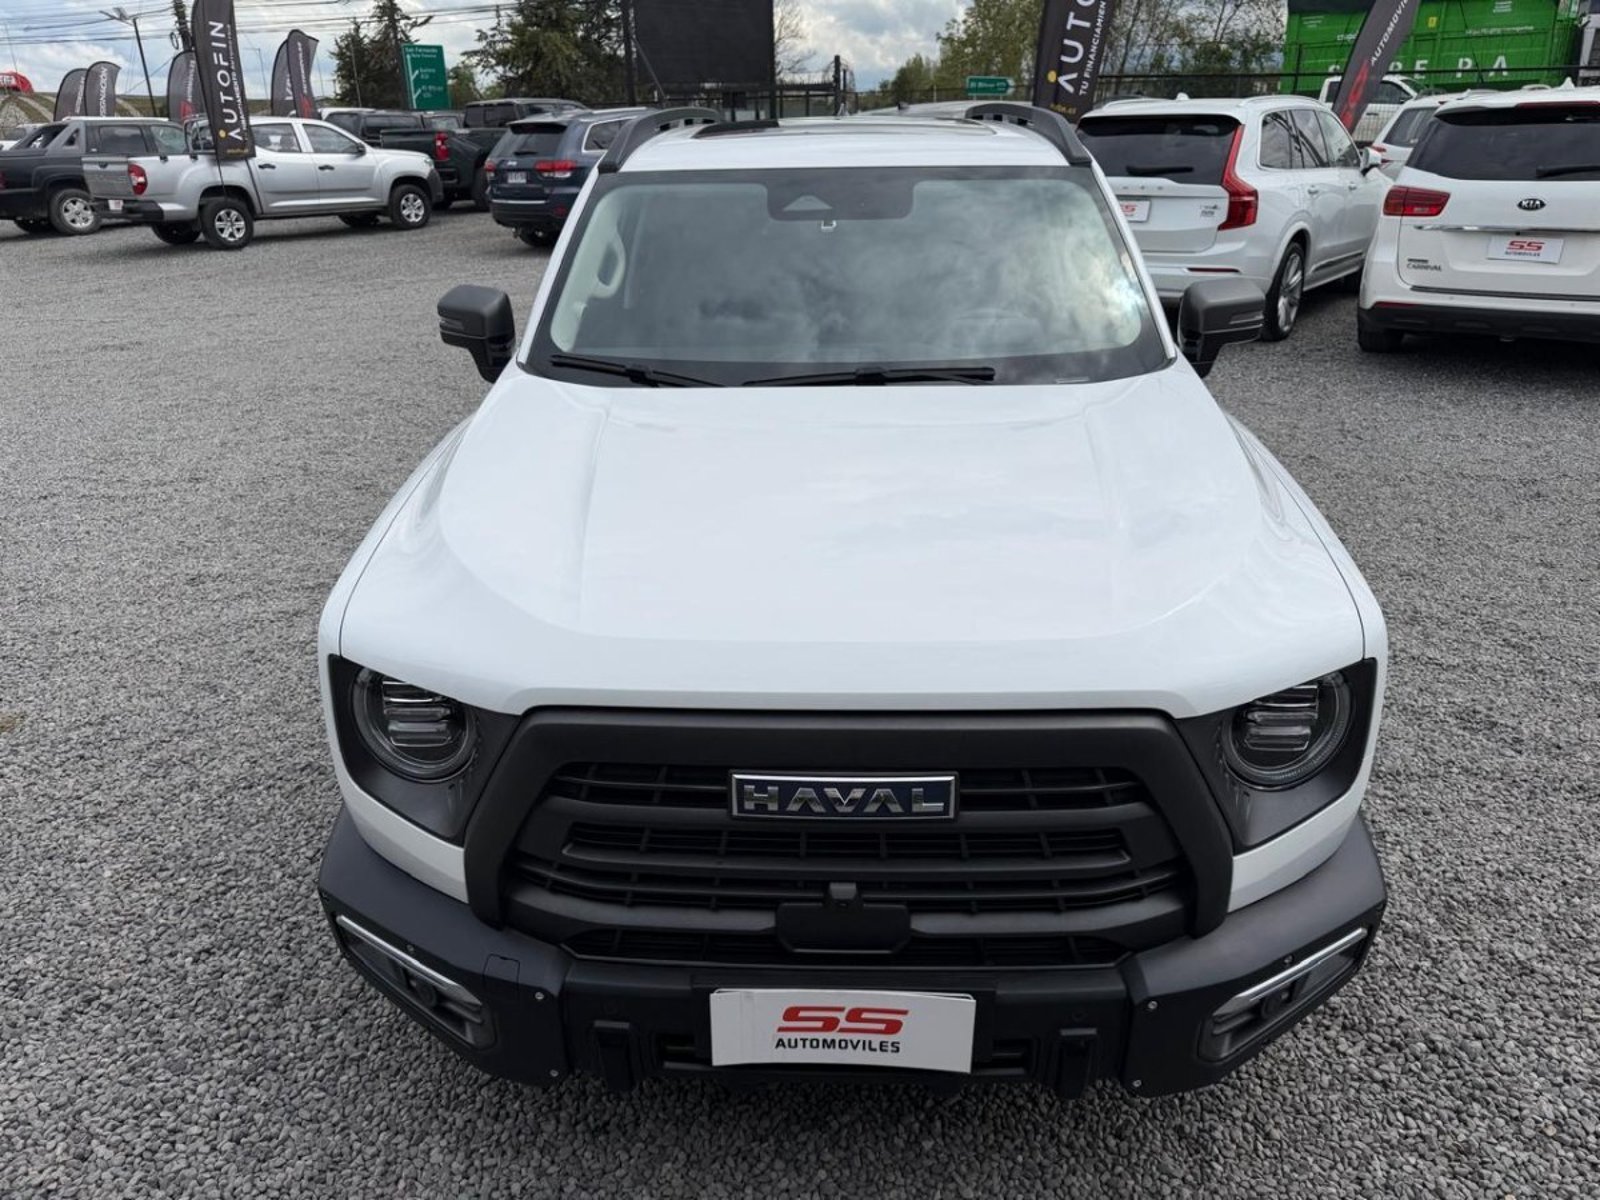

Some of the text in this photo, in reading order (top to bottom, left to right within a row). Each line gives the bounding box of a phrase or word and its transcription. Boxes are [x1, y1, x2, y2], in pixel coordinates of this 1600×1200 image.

[208, 21, 243, 141] AUTOFIN
[1079, 81, 1089, 96] TU
[1506, 240, 1545, 251] SS
[743, 784, 945, 813] HAVAL
[777, 1006, 909, 1036] SS
[775, 1038, 900, 1054] AUTOMOVILES
